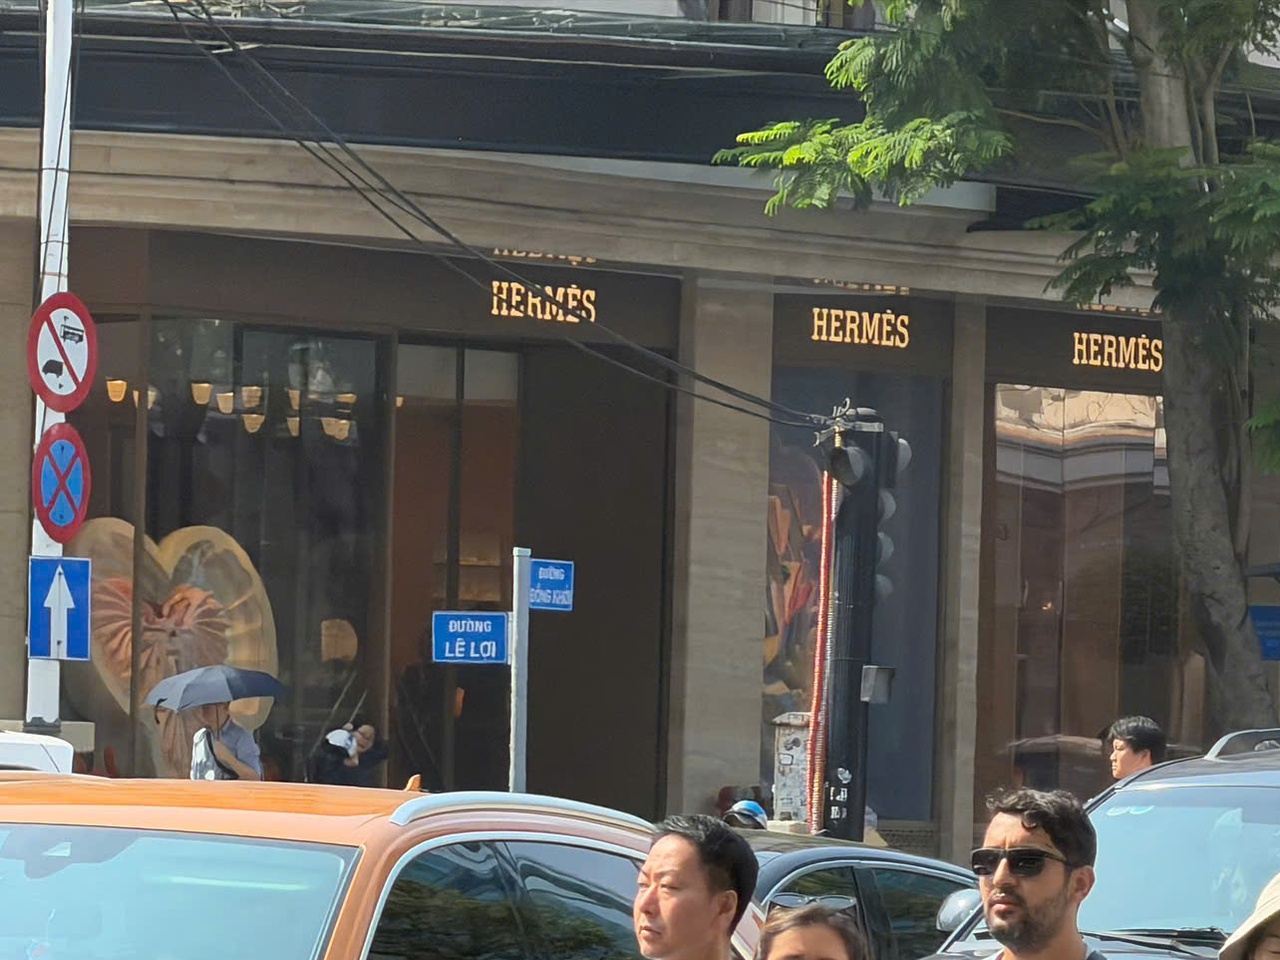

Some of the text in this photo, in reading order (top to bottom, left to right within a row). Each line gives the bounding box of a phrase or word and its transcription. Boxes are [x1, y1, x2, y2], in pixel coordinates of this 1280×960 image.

[491, 280, 597, 323] HERMÈS
[811, 307, 910, 349] HERMÈS
[1072, 332, 1164, 373] HERMÈS
[448, 617, 493, 633] ĐƯỜNG
[444, 638, 466, 658] LÊ
